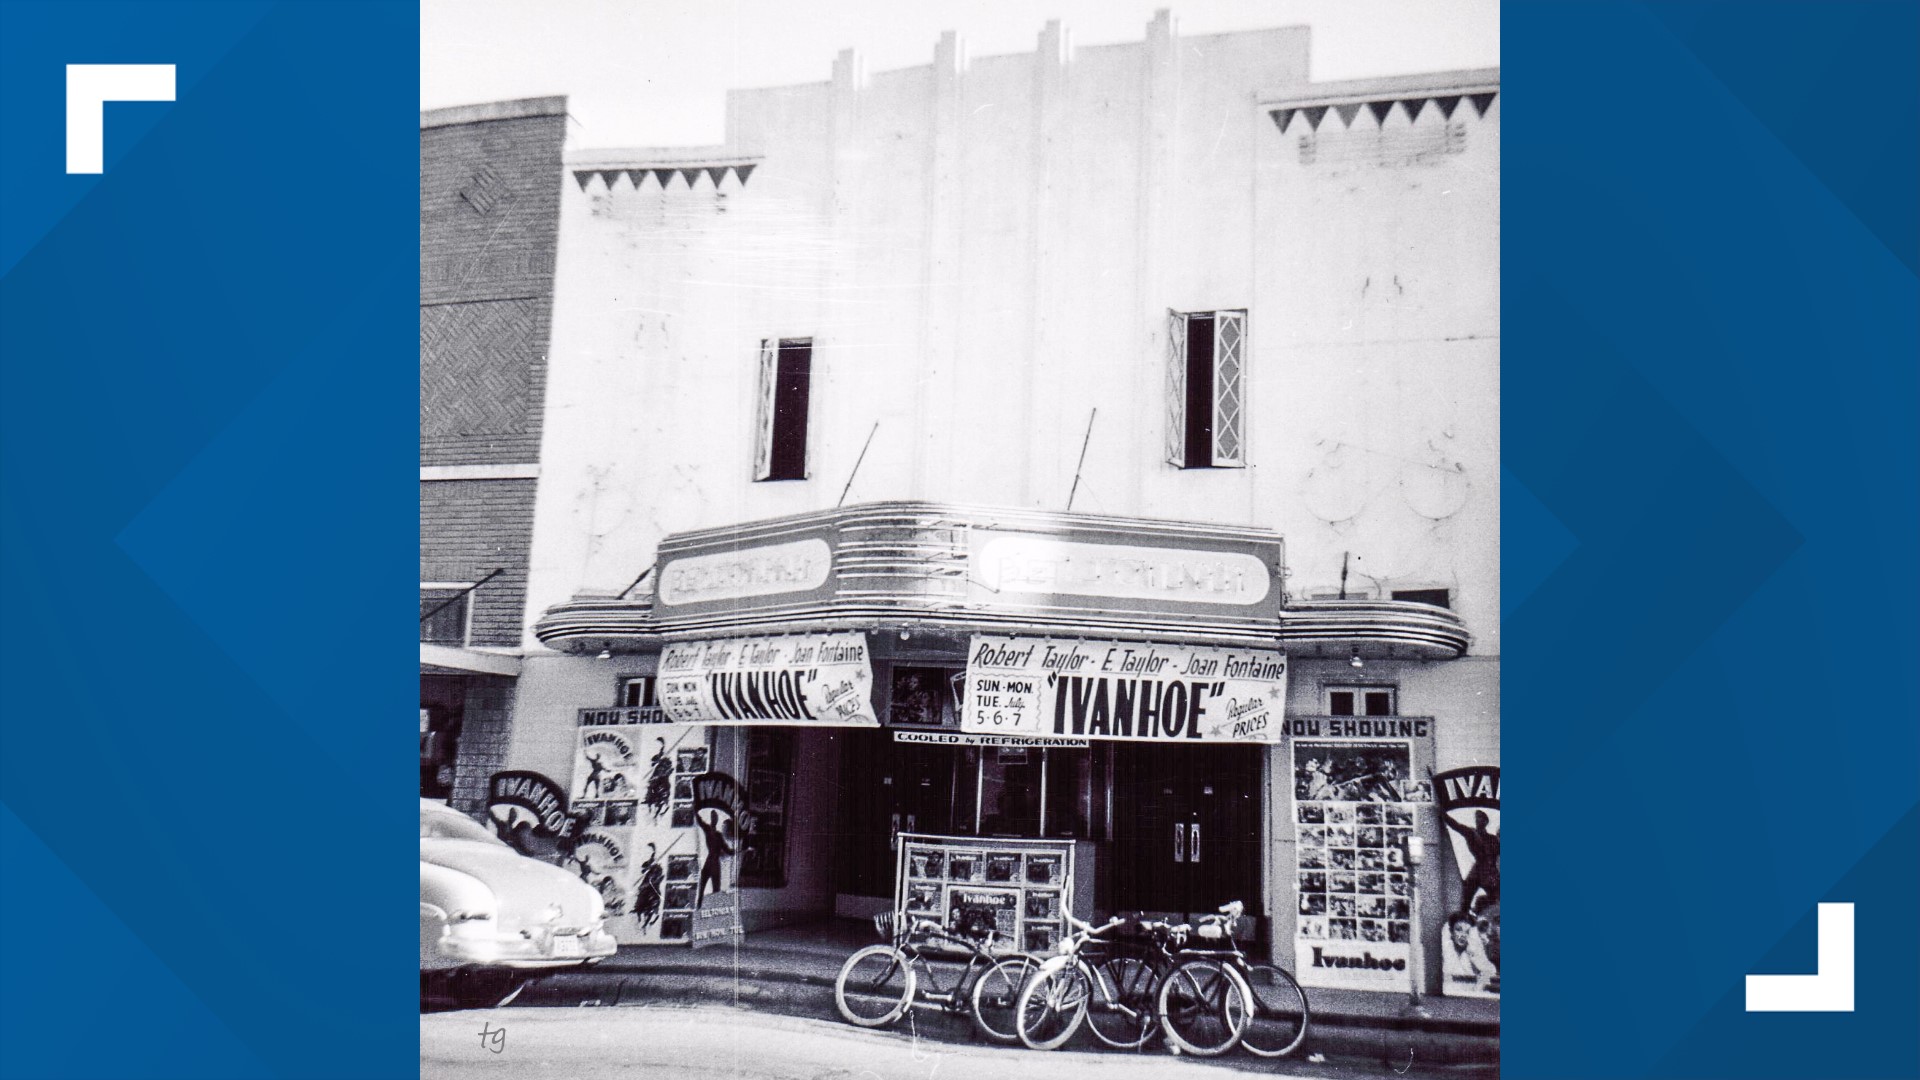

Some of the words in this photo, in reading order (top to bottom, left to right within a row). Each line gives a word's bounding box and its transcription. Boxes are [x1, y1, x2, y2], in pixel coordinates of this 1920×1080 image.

[788, 642, 814, 664] Joan
[818, 641, 864, 663] Fontaine
[971, 643, 1035, 669] Robert
[1041, 645, 1090, 674] Taylor
[1120, 649, 1170, 678] Taylor
[1180, 653, 1218, 677] Joan
[1223, 655, 1285, 680] Fontaine
[706, 669, 819, 720] "IVANHOE"
[1047, 671, 1226, 739] "IVANHOE"
[583, 711, 620, 725] NOW
[1226, 697, 1264, 721] Regular
[1232, 711, 1269, 738] PRICES
[1281, 719, 1319, 736] NOW
[1330, 720, 1427, 737] SHOWING
[897, 732, 959, 743] COOLED
[965, 736, 975, 745] by
[980, 737, 1087, 746] REFRIGERATION
[1444, 775, 1500, 801] IVA
[497, 777, 577, 837] IVANHOE
[963, 893, 1006, 905] Ivanhoe
[1312, 946, 1406, 971] Ivanhoe
